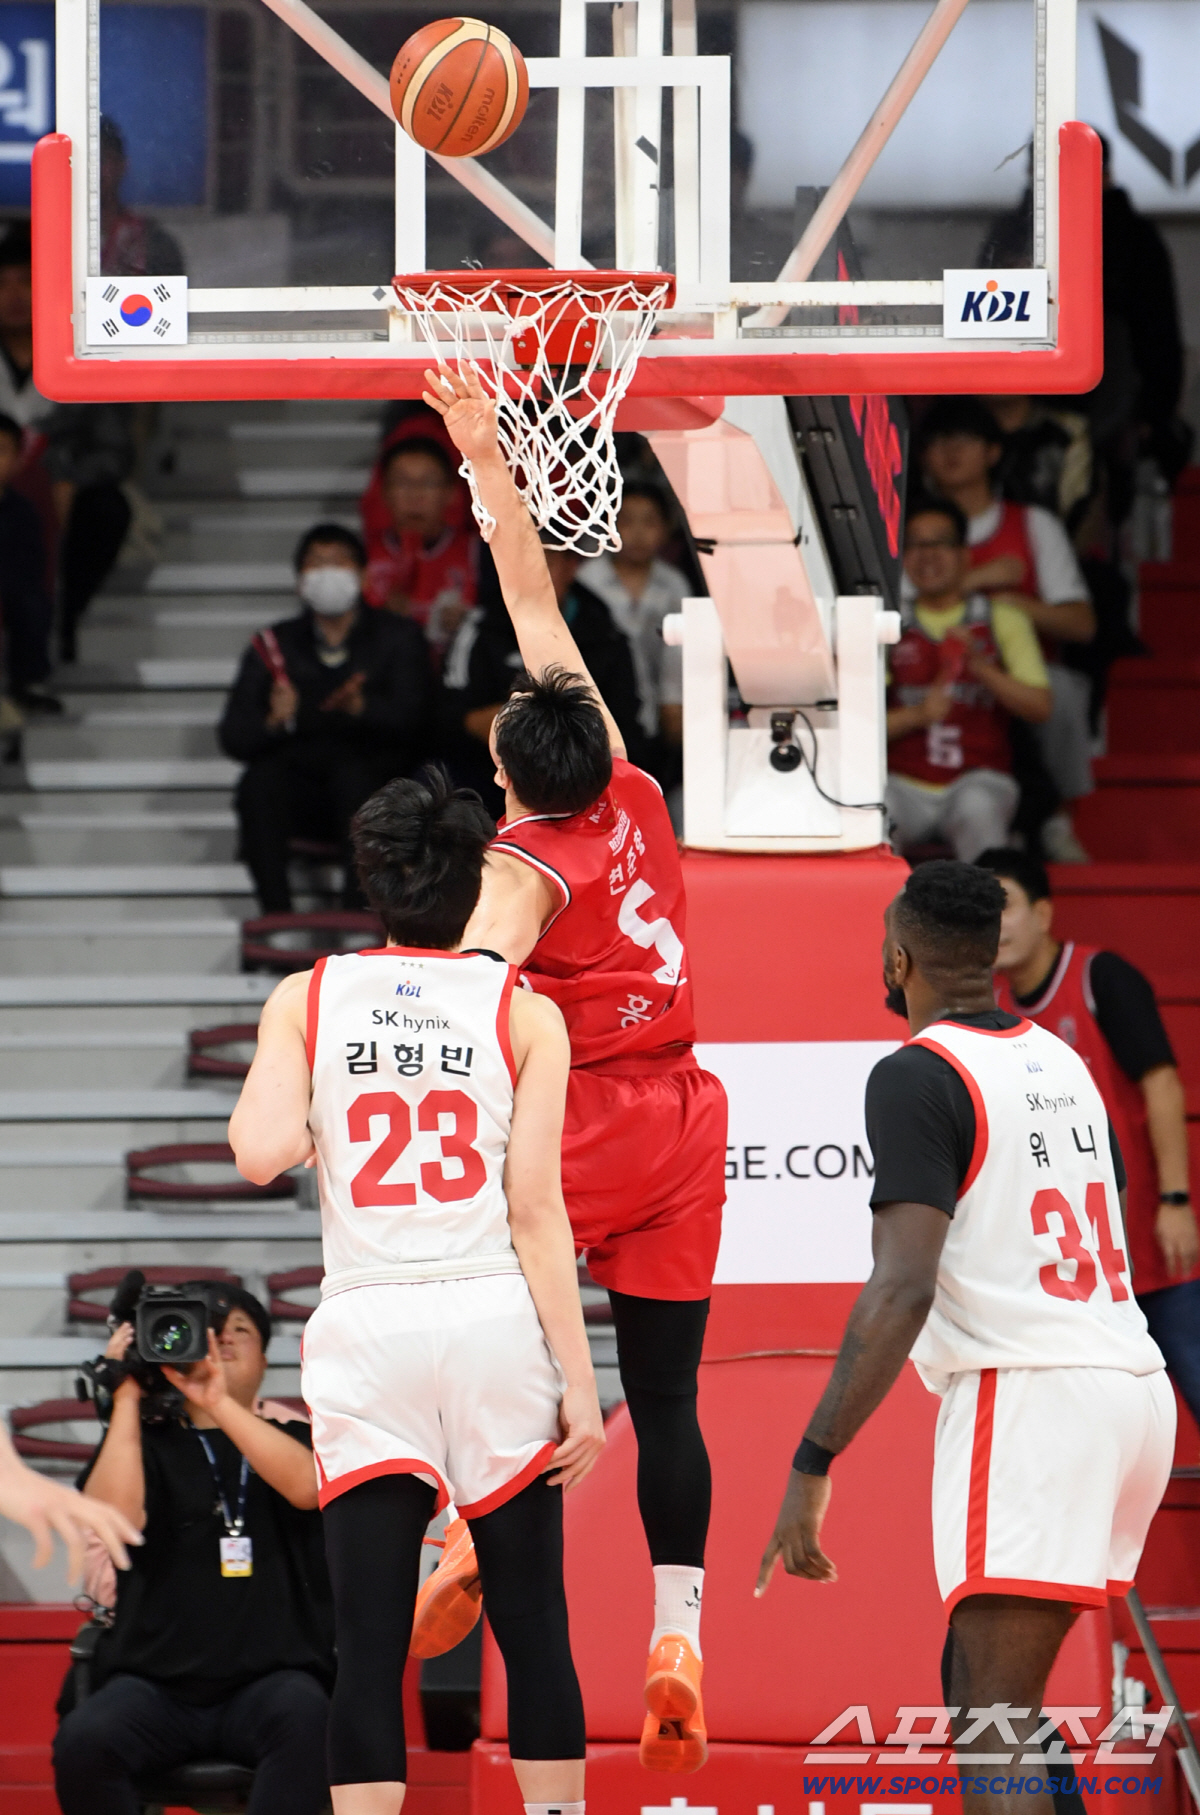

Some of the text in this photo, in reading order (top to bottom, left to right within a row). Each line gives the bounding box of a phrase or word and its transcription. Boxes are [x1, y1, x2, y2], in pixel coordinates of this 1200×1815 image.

[461, 88, 496, 142] molten
[960, 288, 1031, 322] KBL
[395, 983, 421, 998] KBL
[371, 1009, 450, 1033] SK hynix
[345, 1041, 473, 1077] 김형빈
[1026, 1092, 1077, 1113] SK hynix
[346, 1089, 487, 1208] 23
[1030, 1182, 1129, 1303] 34
